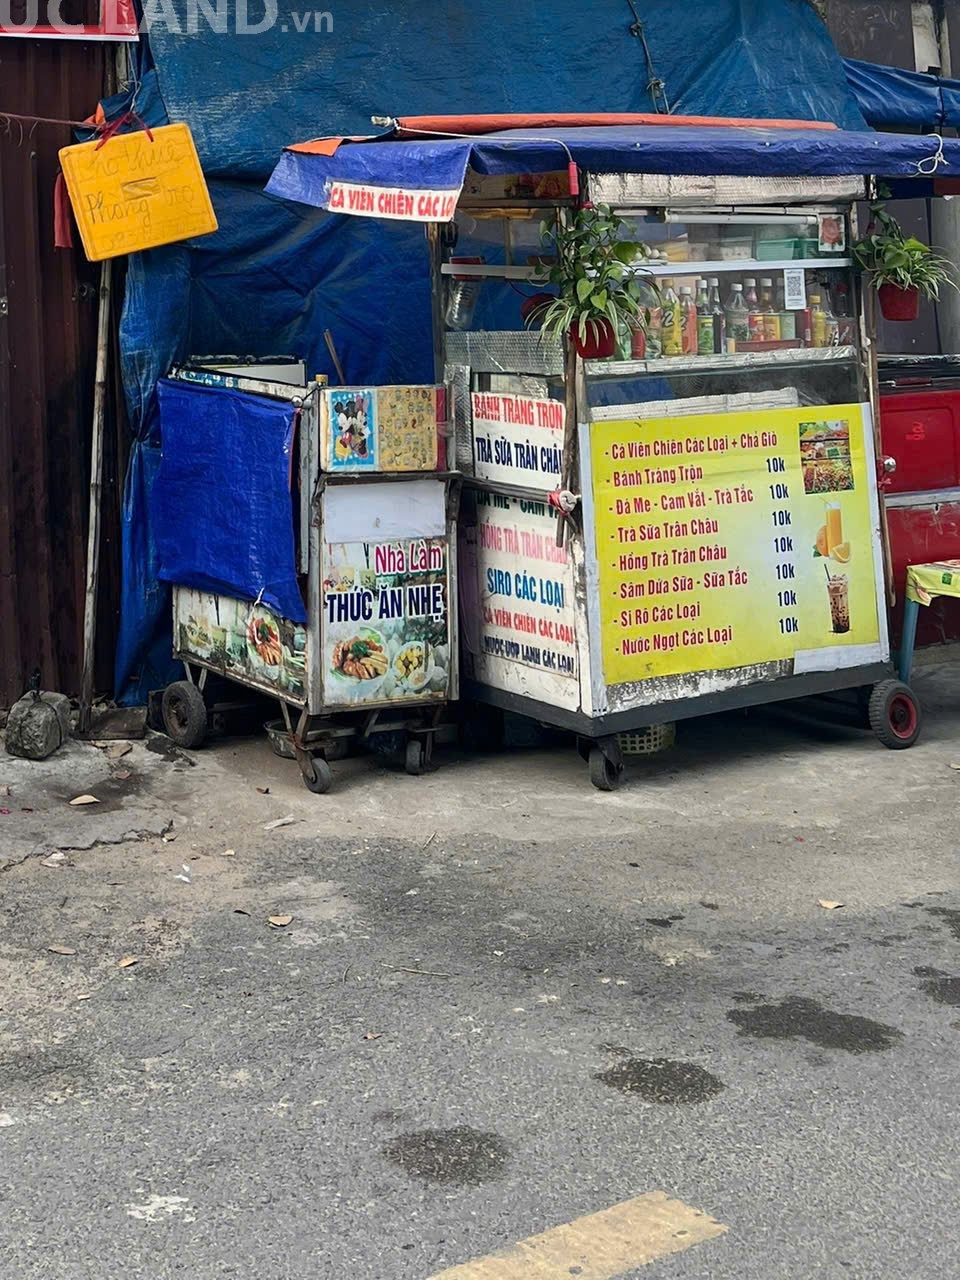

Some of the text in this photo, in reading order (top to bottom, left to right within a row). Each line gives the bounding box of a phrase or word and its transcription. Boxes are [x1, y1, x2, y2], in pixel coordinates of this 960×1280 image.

[330, 184, 345, 208] CÁ
[348, 187, 374, 212] VIÊN
[378, 190, 413, 216] CHIÊN
[417, 192, 440, 217] CÁC
[502, 395, 535, 425] TRÁNG
[536, 399, 563, 435] TRỘN
[476, 433, 493, 464] TRÀ
[495, 436, 513, 467] SỮA
[514, 439, 538, 471] TRÂN
[628, 439, 650, 458] Viên
[653, 438, 683, 456] Chiên
[685, 437, 704, 453] Các
[707, 435, 729, 454] Loại
[740, 431, 758, 448] Chả
[613, 457, 785, 487] Bánh Tráng Trộn 10k
[616, 483, 789, 515] Đá Me Cam Vắt Trà Tắc 10k
[503, 524, 520, 555] TRÀ
[618, 509, 791, 543] Trà Sữa Trân Châu 10k
[374, 540, 442, 574] Nhà Làm
[619, 536, 793, 571] Hồng Trà Trân Châu 10k
[486, 567, 565, 613] SIRO CÁC LOẠI
[620, 563, 795, 599] Sâm Dứa Sữa Sữa Tắc 10k
[326, 584, 442, 623] THỨC ĂN NHẸ
[652, 605, 673, 623] Các
[676, 601, 700, 621] Loại
[777, 590, 797, 607] 10k
[494, 607, 512, 628] VIÊN
[513, 612, 536, 634] CHIÊN
[538, 616, 553, 639] CÁC
[555, 623, 574, 647] LOẠI
[622, 617, 799, 655] Nước Ngọt Các Loại 10k
[542, 648, 556, 669] CÁC
